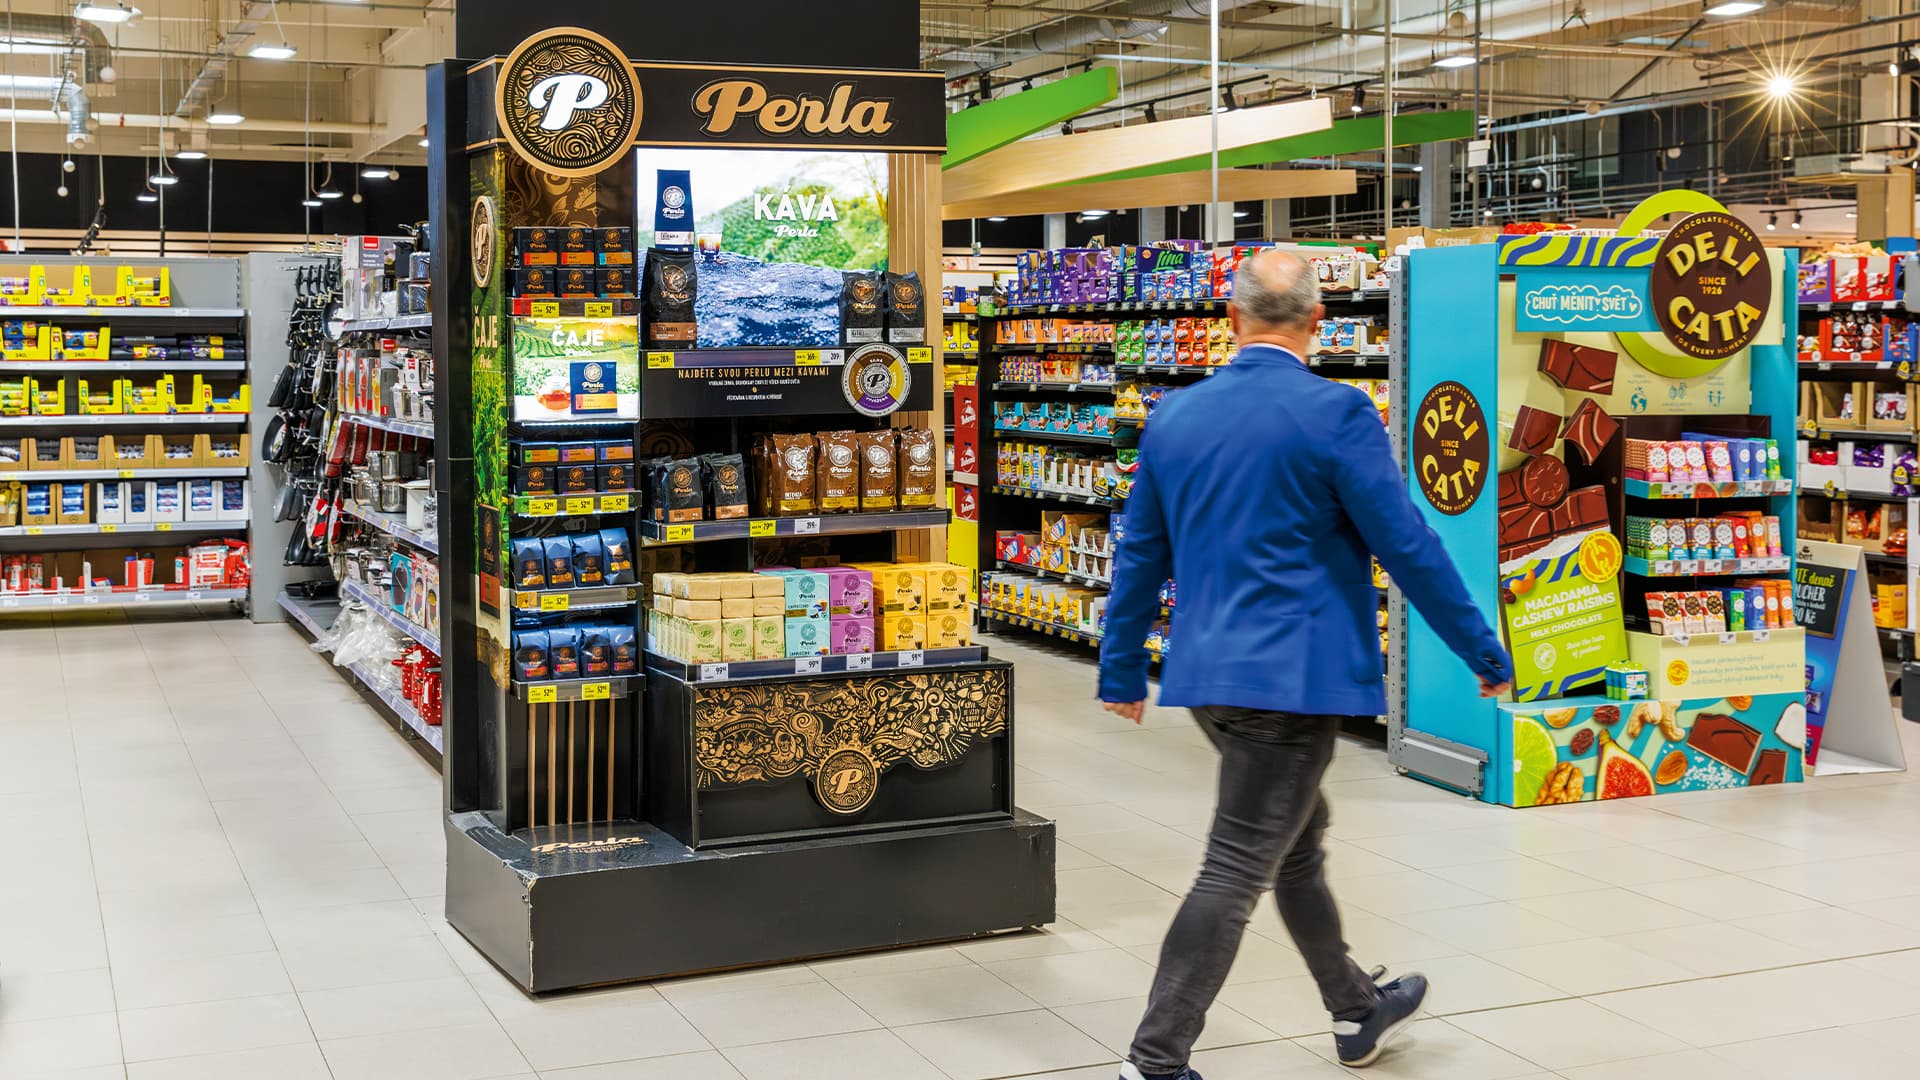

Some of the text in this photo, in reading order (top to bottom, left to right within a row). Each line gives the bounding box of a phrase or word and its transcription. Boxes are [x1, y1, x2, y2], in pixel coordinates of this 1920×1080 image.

[528, 73, 608, 131] P
[695, 80, 894, 135] Perla
[754, 185, 838, 221] KÁVA
[774, 225, 818, 238] Perla
[1666, 231, 1760, 277] DELI
[1698, 277, 1727, 286] SINCE
[1702, 286, 1723, 295] 1926
[1532, 291, 1627, 311] CHUŤ MĚNIT SVĚT
[474, 305, 498, 348] ČAJE
[1669, 296, 1761, 342] CATA
[552, 323, 604, 346] ČAJE
[1675, 334, 1748, 356] FOR EVERY MOMENT
[679, 366, 829, 379] NAJDĚTE SVOU PERLU MEZI KÁVAMI
[1422, 395, 1479, 440] DELI
[1440, 440, 1459, 448] SINCE
[1443, 449, 1456, 457] 1926
[1422, 454, 1480, 500] CATA
[1525, 583, 1600, 612] MACADAMIA
[1796, 584, 1826, 602] UCHER
[1513, 592, 1616, 628] CASHEW RAISINS
[1530, 613, 1603, 638] MILK CHOCOLATE
[830, 768, 863, 794] P
